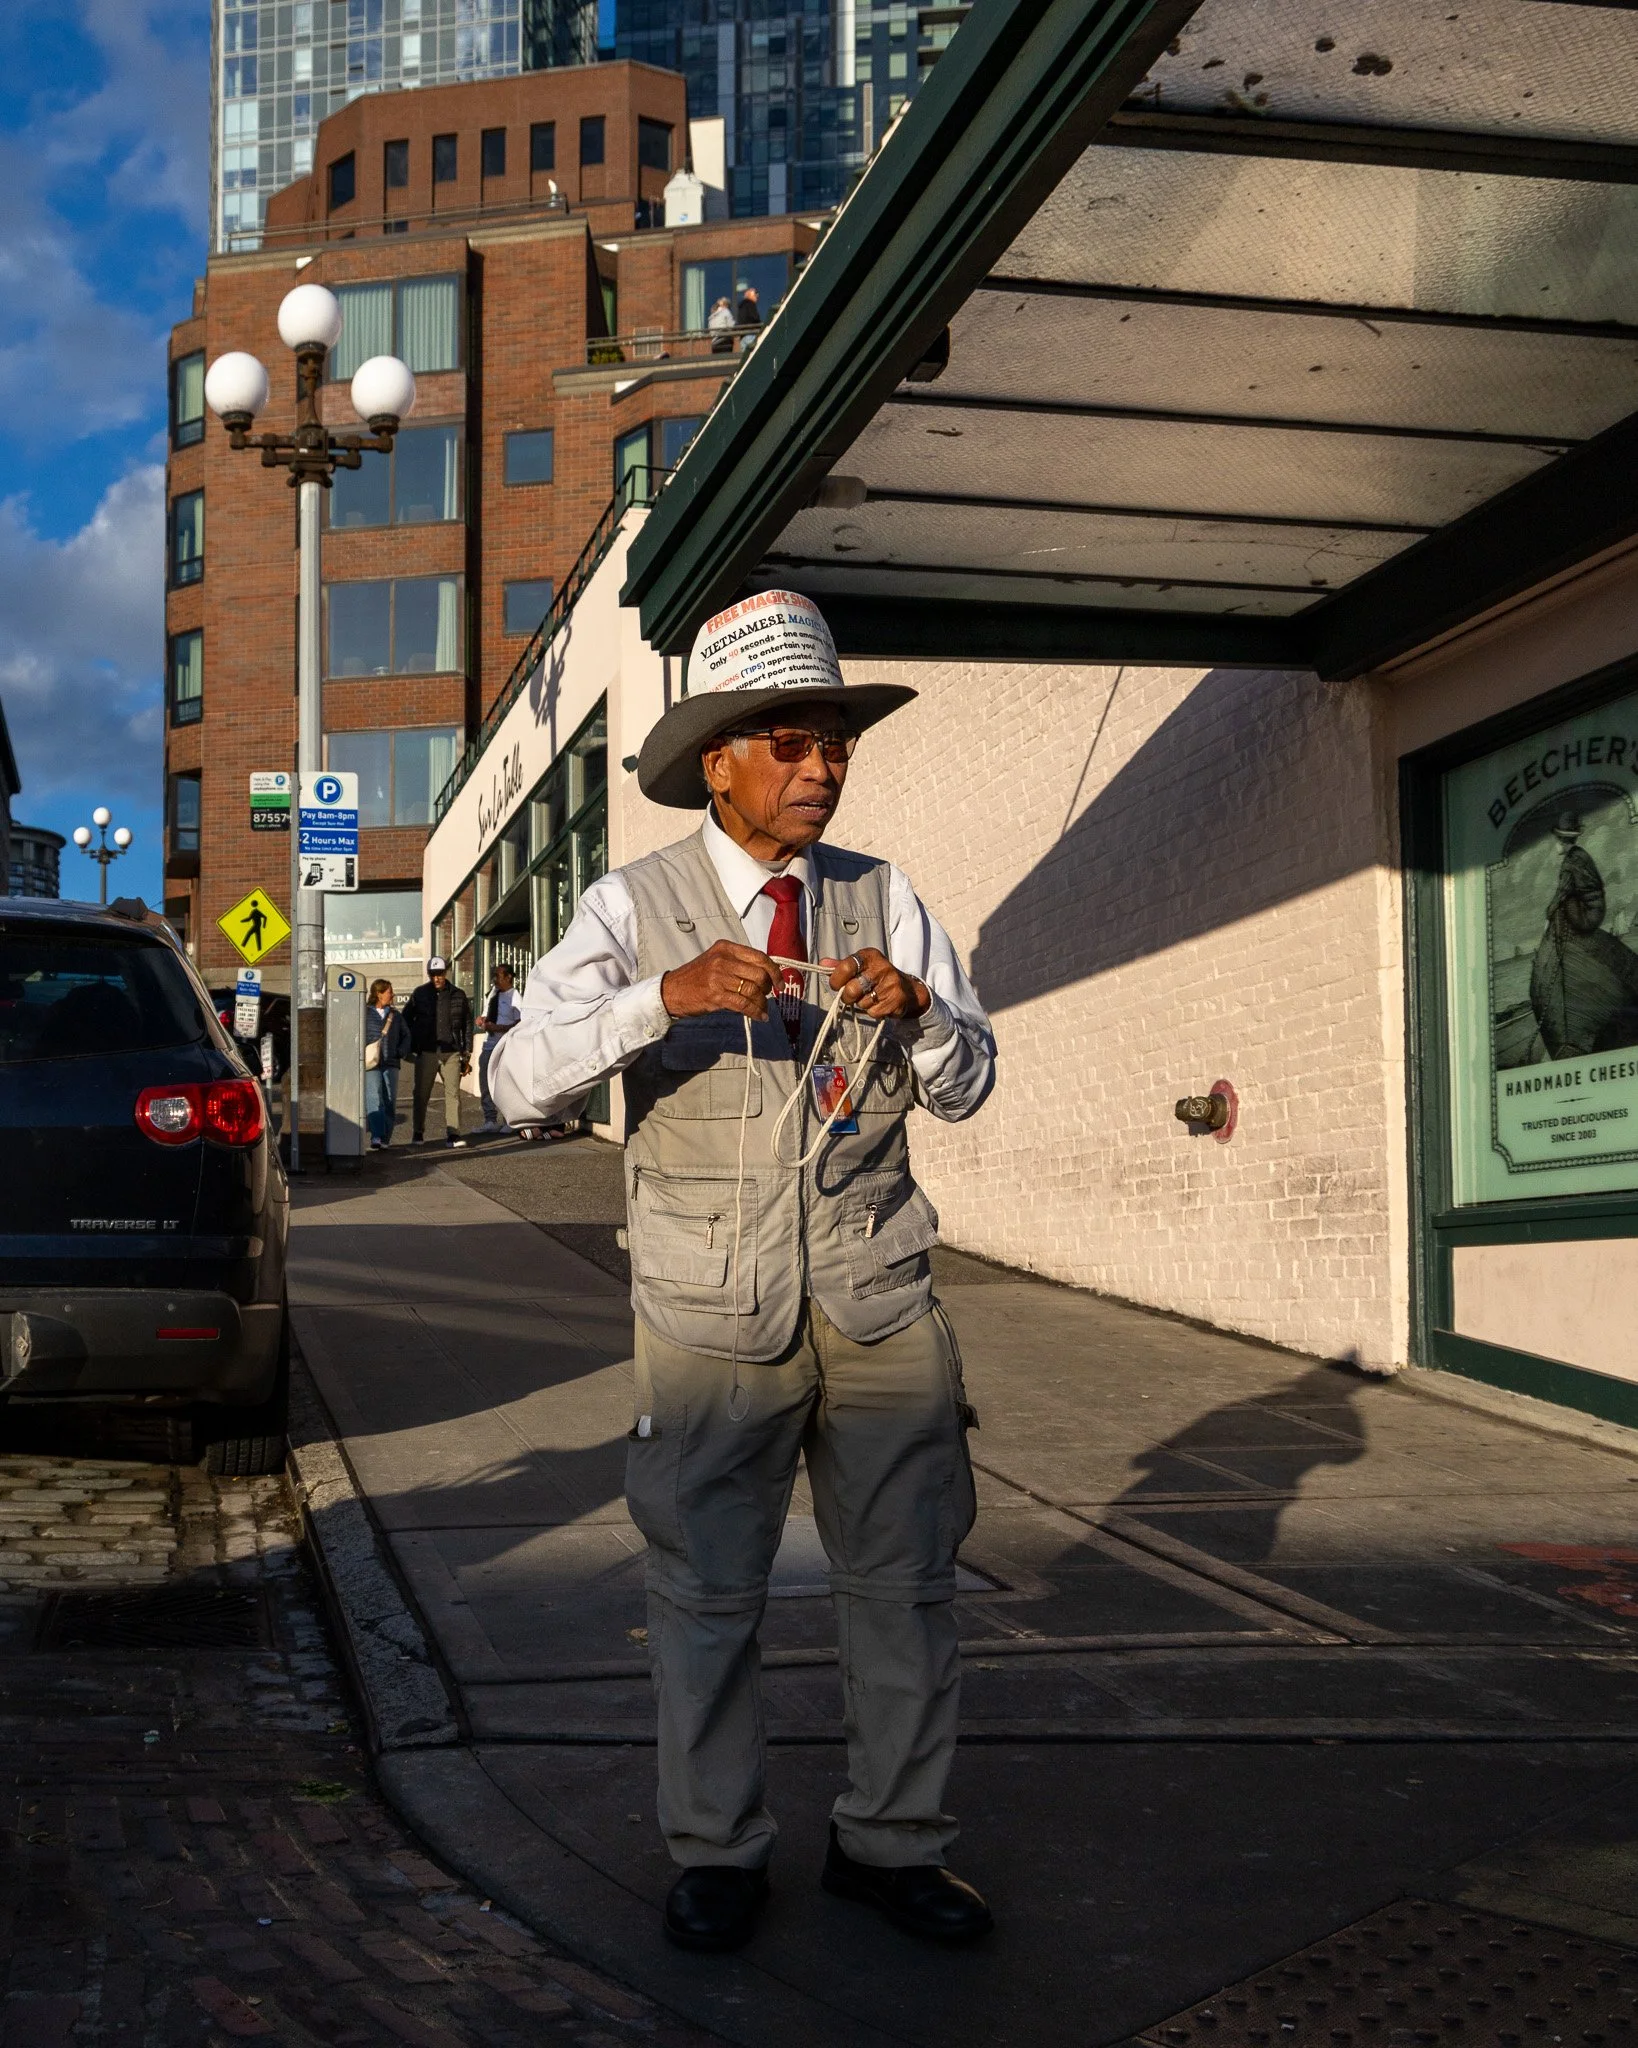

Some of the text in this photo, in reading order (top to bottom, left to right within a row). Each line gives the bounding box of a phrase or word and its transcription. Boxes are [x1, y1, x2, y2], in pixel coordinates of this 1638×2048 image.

[706, 606, 739, 634] FREE
[742, 591, 790, 614] MAGIC
[700, 613, 786, 662] VIETNAMESE
[710, 655, 727, 671] Only
[729, 648, 739, 660] 40
[740, 634, 775, 653] seconds
[783, 630, 797, 638] one
[760, 641, 800, 656] entertain
[709, 673, 740, 692] ATIONS
[740, 661, 766, 679] (TIPS)
[767, 653, 812, 667] appreciated
[736, 673, 767, 692] support
[768, 665, 787, 679] poor
[789, 662, 820, 672] students
[781, 677, 798, 689] you
[800, 675, 809, 684] so
[323, 782, 337, 799] P
[478, 741, 524, 853] Sur La Table
[253, 813, 287, 823] 87557
[301, 811, 355, 821] Pay 8am-8pm
[302, 833, 355, 846] 2 Hours Max
[1506, 1061, 1638, 1097] HANDMADE CHEES
[1521, 1108, 1629, 1131] TRUSTED DELICIOUSNESS
[1551, 1129, 1597, 1144] SINCE 2003
[70, 1219, 179, 1229] TRAVERSE LT
